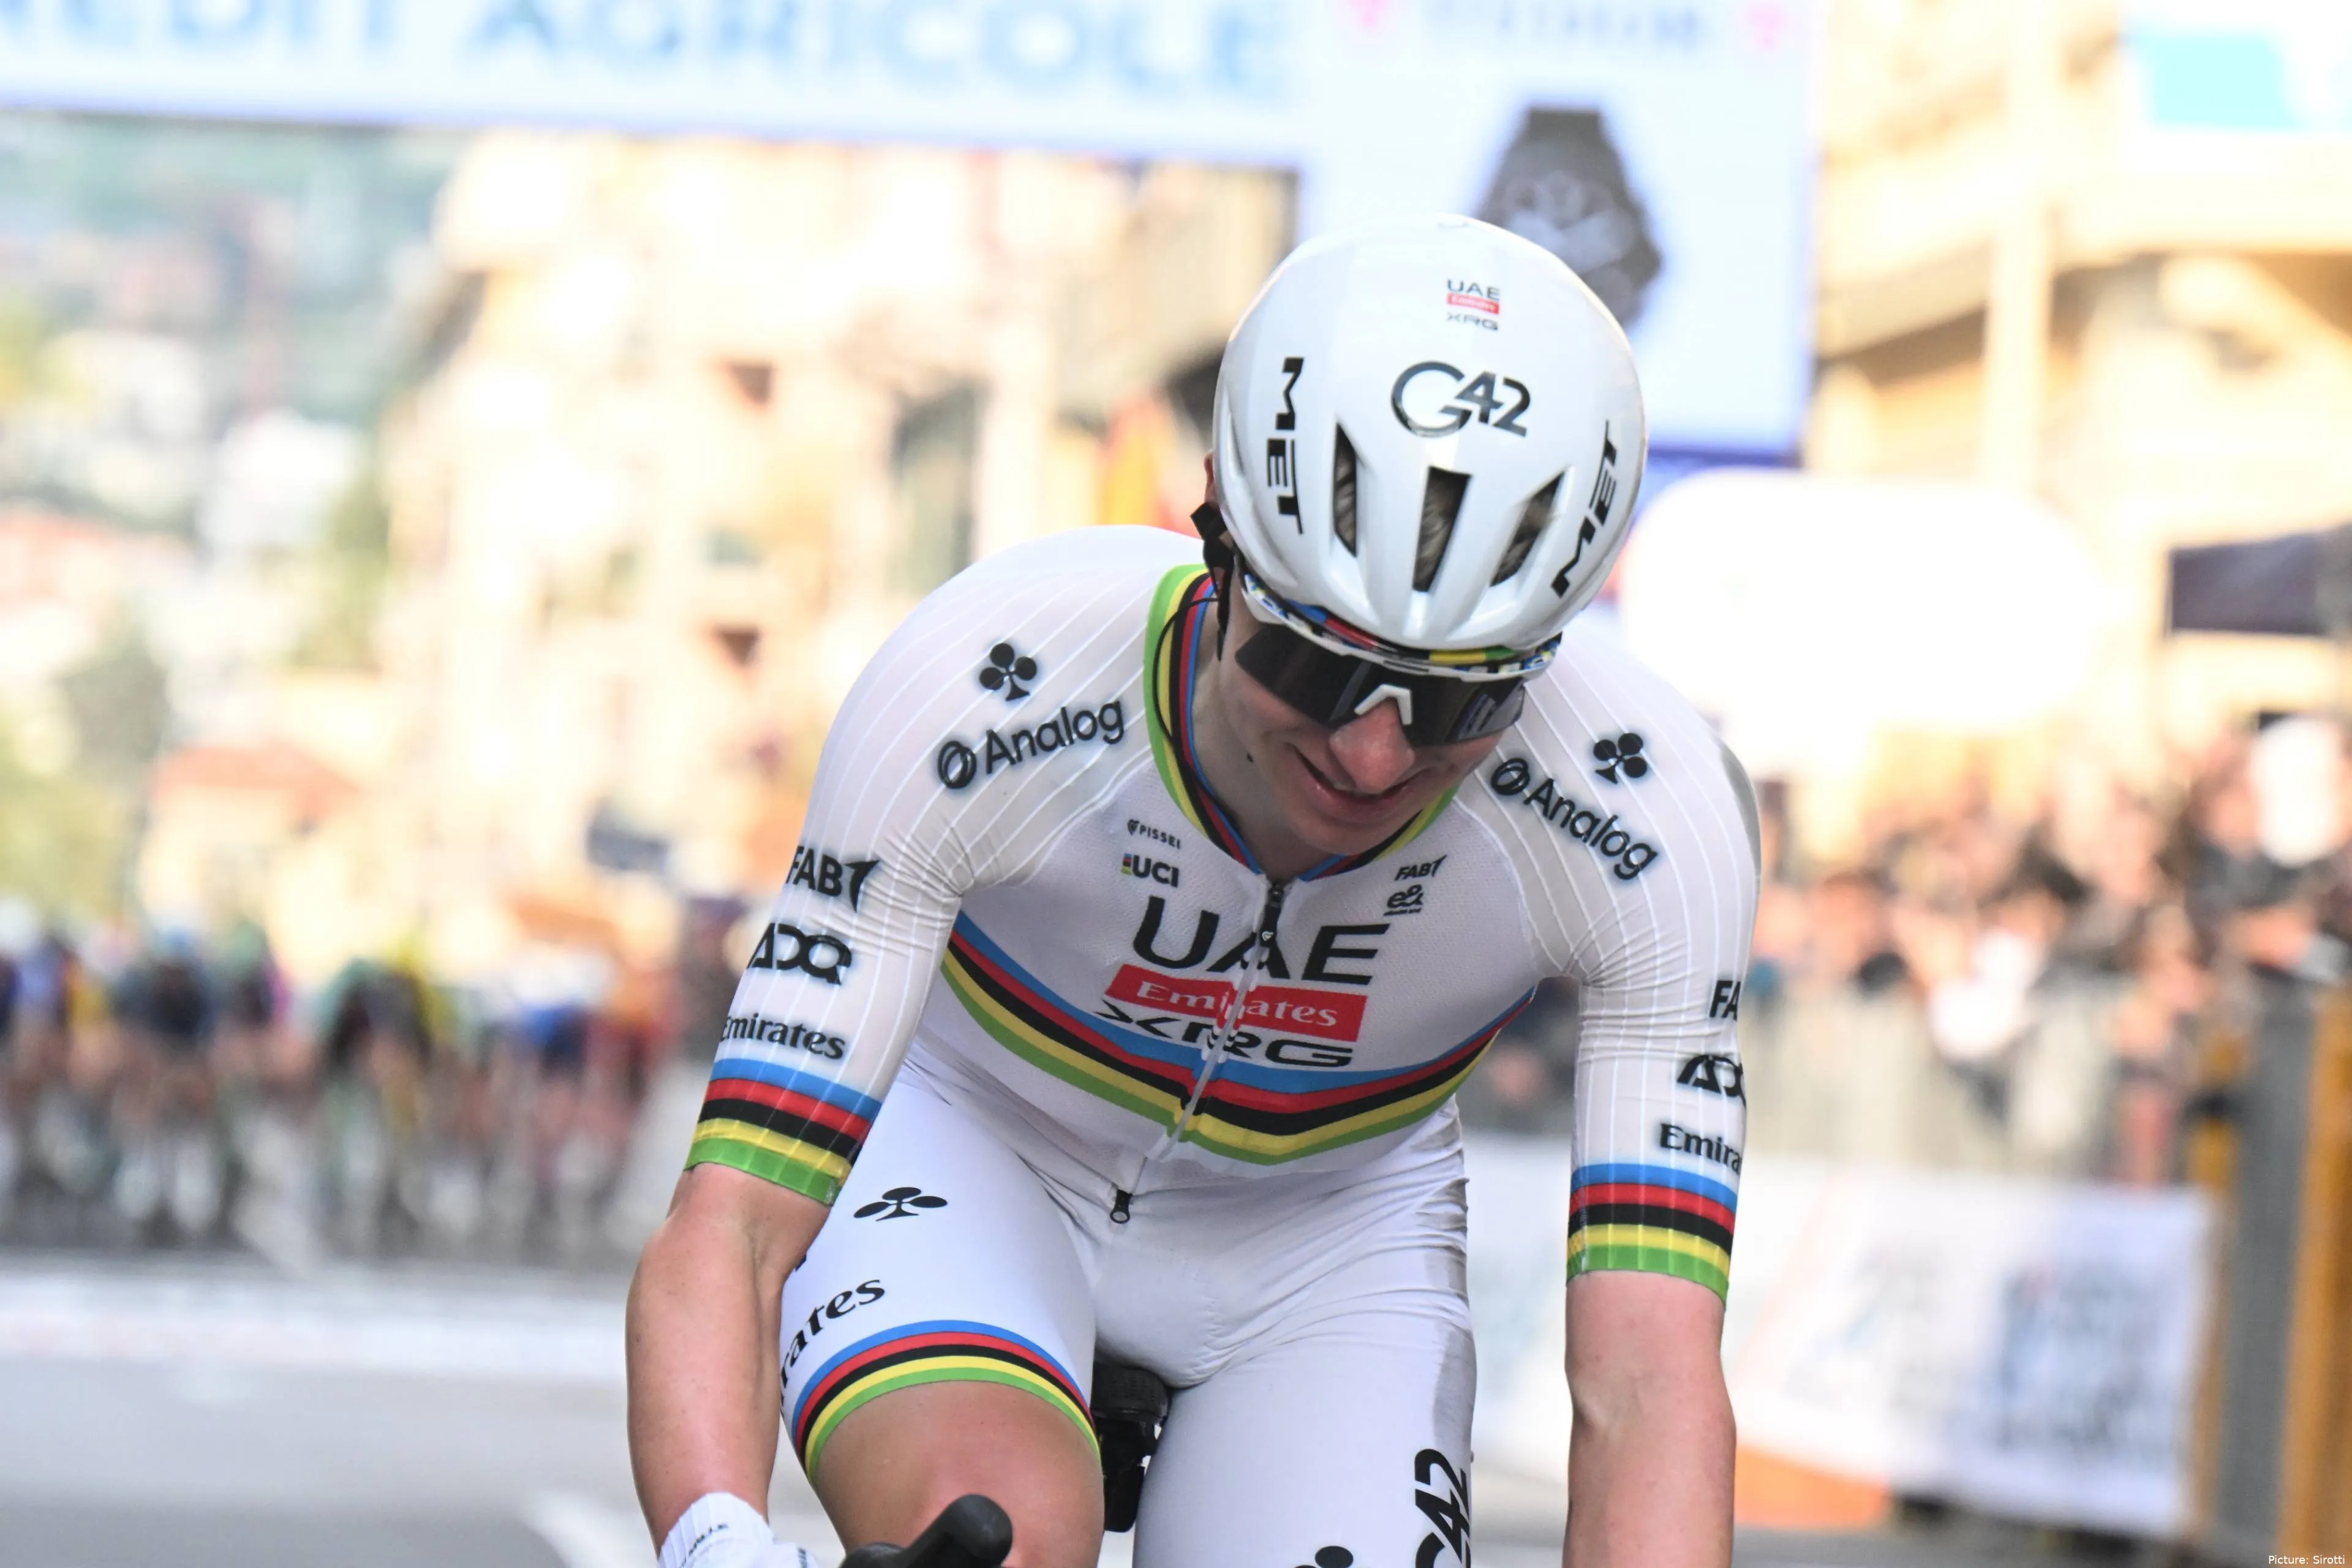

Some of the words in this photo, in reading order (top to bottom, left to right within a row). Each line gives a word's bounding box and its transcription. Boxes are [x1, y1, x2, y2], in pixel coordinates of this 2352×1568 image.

[459, 0, 1291, 98] AGRICOLE
[1447, 279, 1500, 301] UAE
[1447, 312, 1498, 331] XRG
[1391, 361, 1531, 437] G42
[1267, 356, 1305, 535] MET
[1550, 420, 1619, 598] MET
[985, 699, 1125, 774] Analog
[1139, 824, 1180, 850] PISSEI
[1523, 777, 1659, 881] Analog
[1132, 854, 1179, 888] UCI
[1132, 895, 1390, 986] UAE
[1093, 1000, 1352, 1068] XRG
[1677, 1054, 1746, 1110] AD
